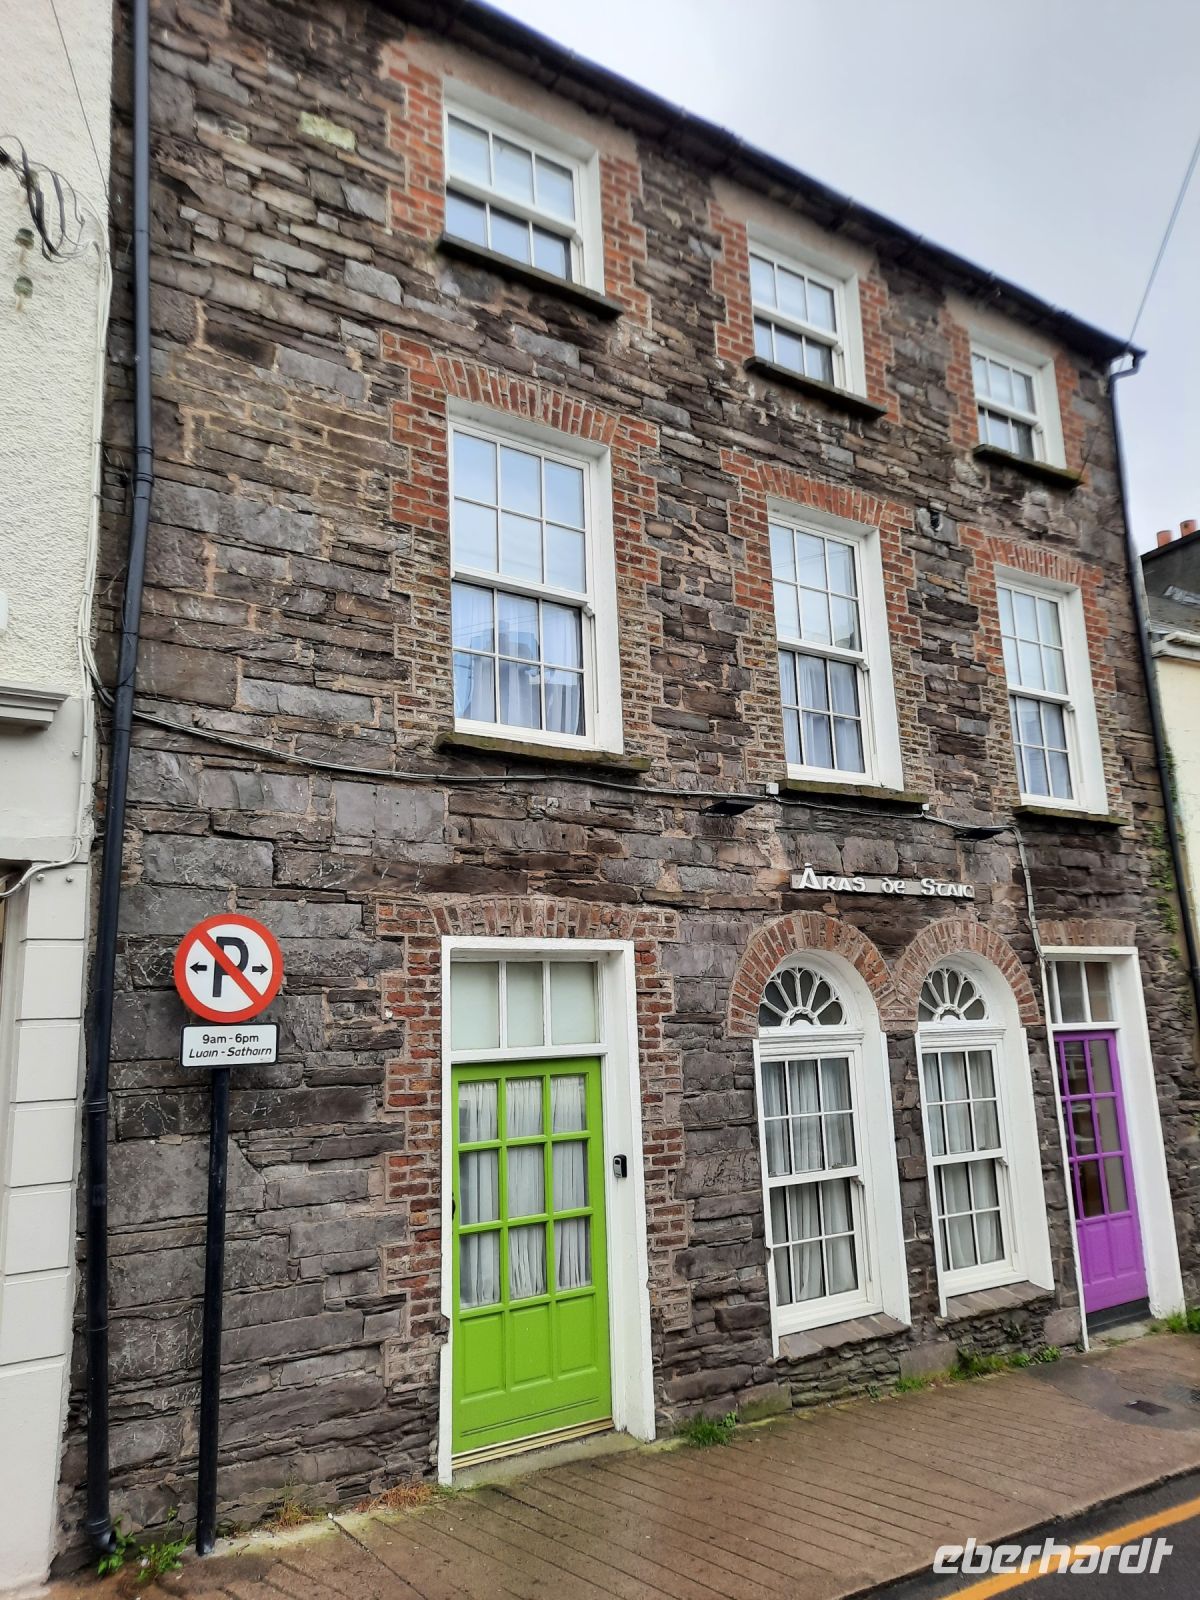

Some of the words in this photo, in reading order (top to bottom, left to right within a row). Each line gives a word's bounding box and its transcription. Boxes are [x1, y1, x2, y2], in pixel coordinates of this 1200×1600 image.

[212, 936, 249, 998] P
[202, 1034, 227, 1045] 9am
[235, 1033, 259, 1044] 6pm
